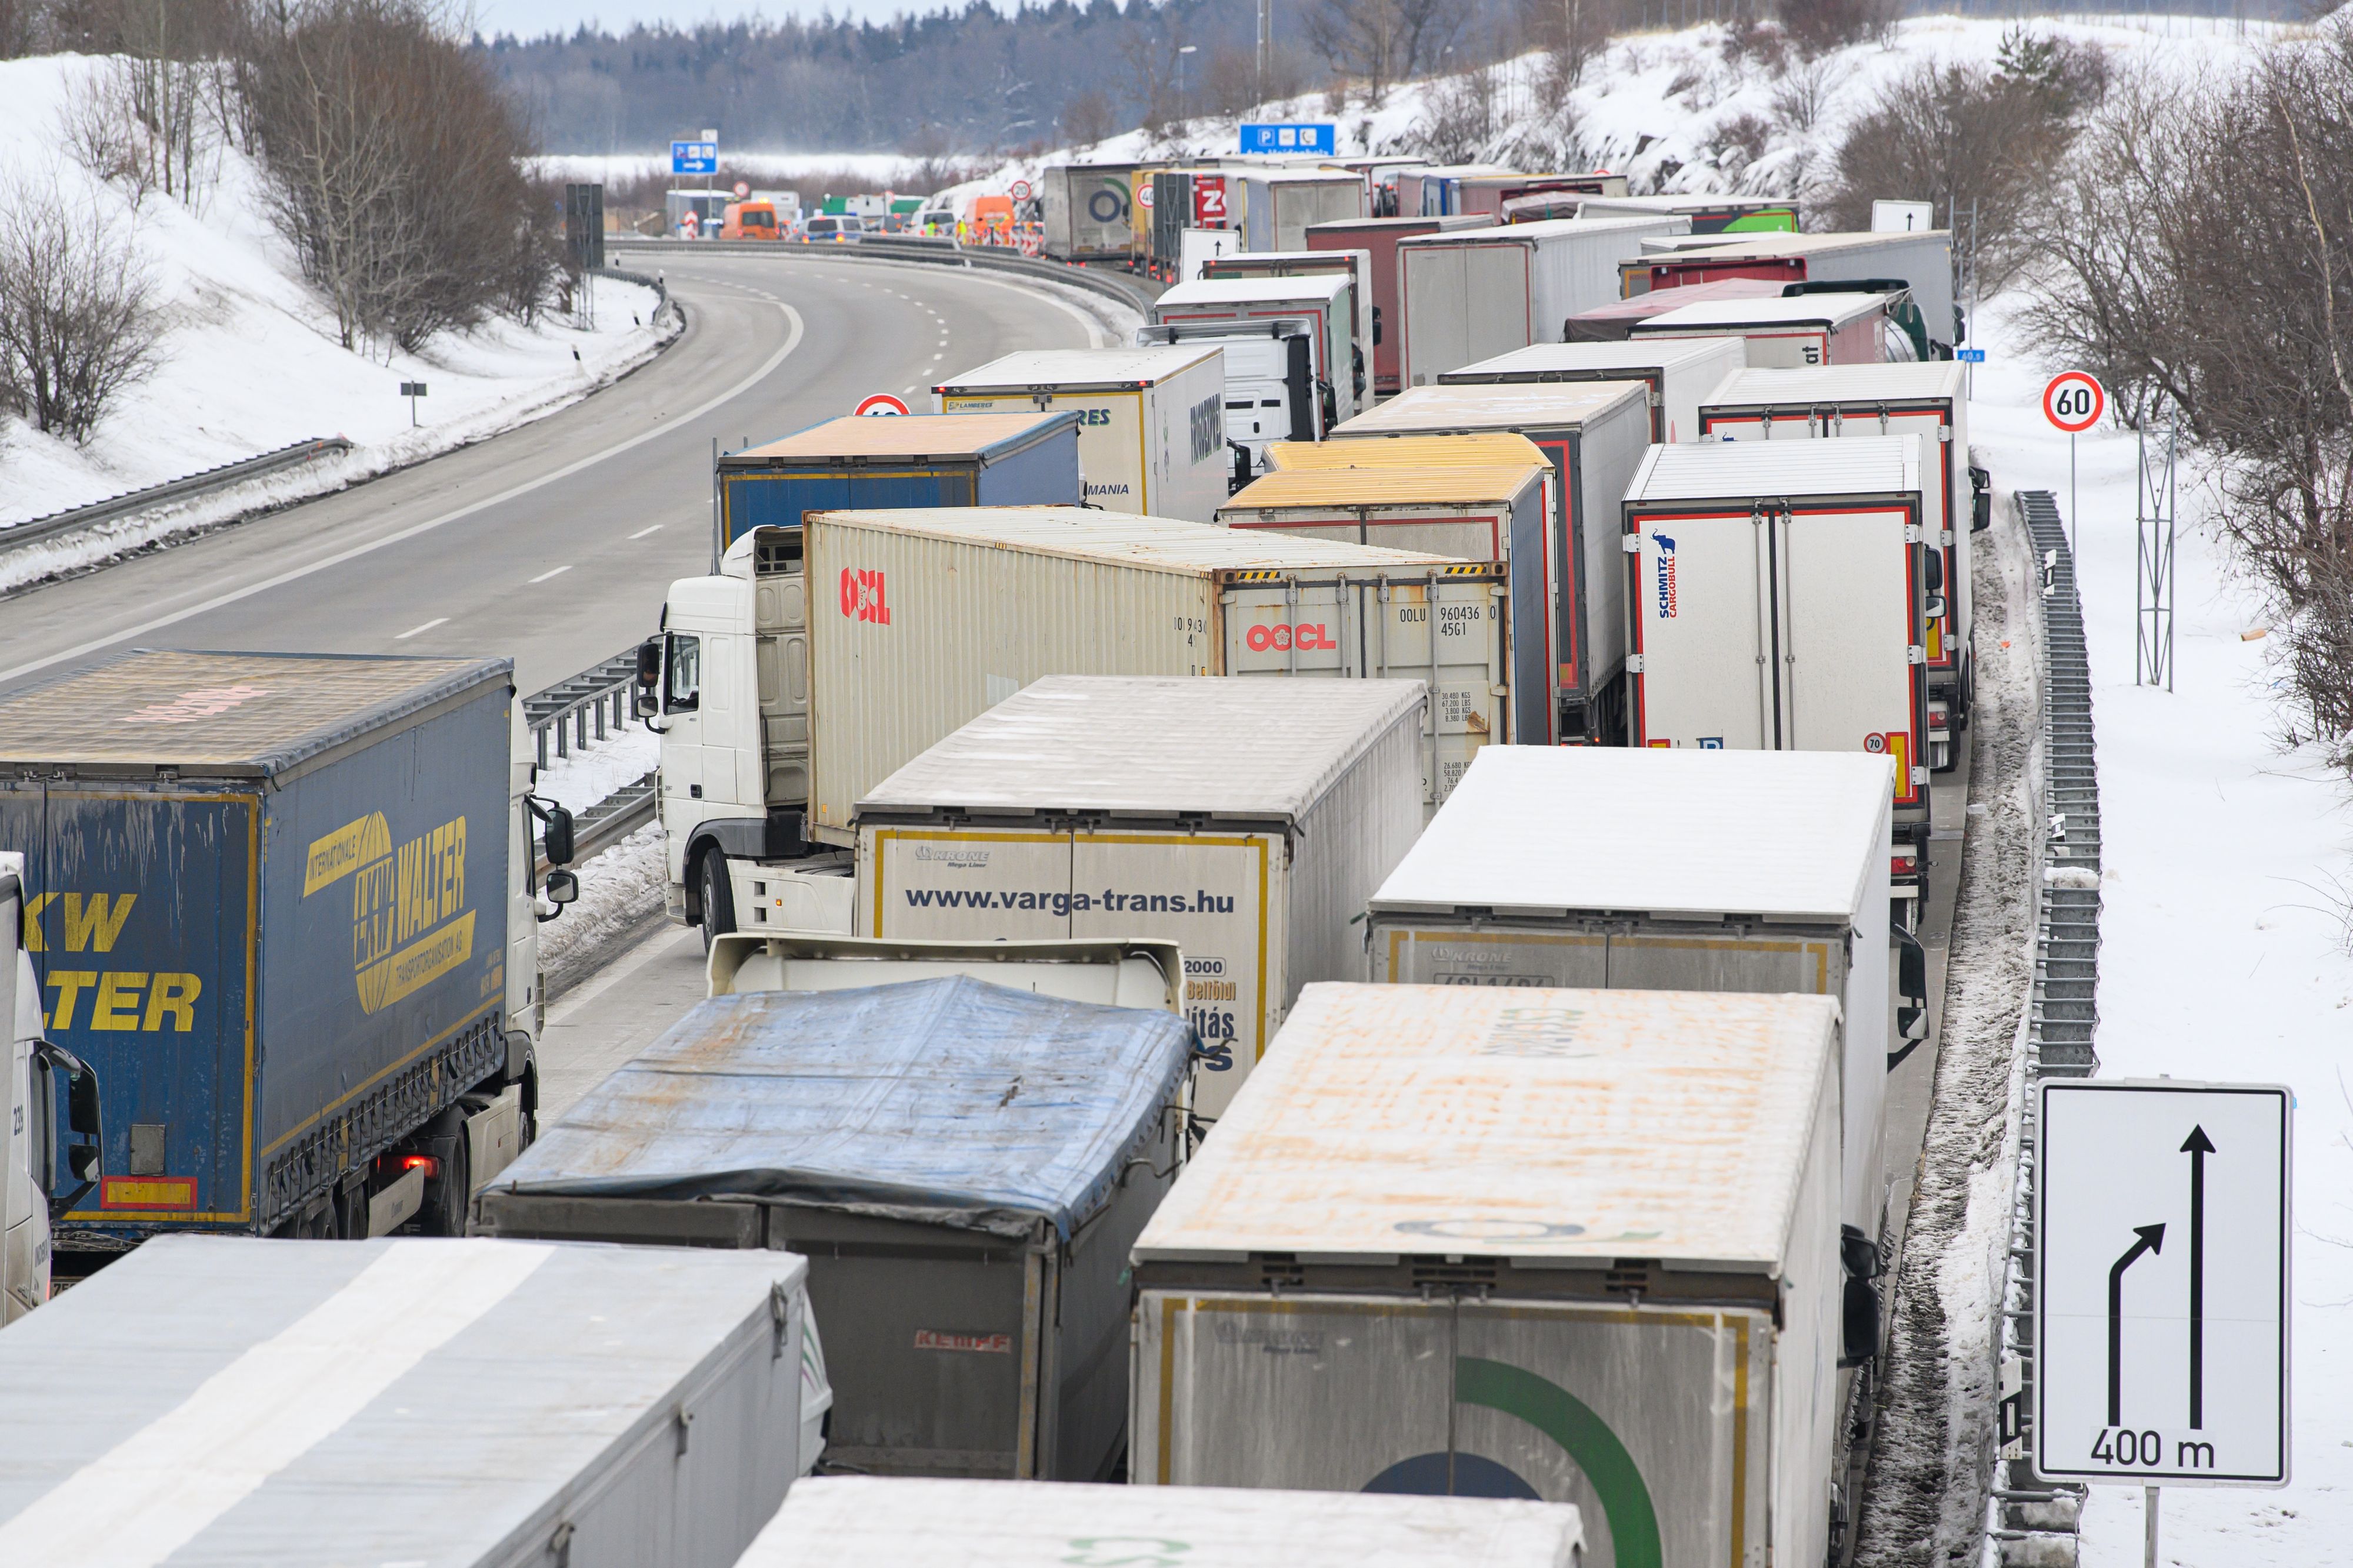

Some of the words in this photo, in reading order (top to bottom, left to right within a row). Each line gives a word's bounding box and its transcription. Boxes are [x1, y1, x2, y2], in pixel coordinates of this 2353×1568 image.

[1016, 185, 1027, 195] 20
[2057, 389, 2089, 415] 60
[1658, 556, 1669, 619] SCHMITZ
[1668, 556, 1677, 618] CARGOBULL
[1441, 606, 1479, 620] 960436
[1247, 623, 1336, 652] OOCL
[1441, 622, 1466, 636] 45G1
[1869, 739, 1880, 749] 70
[309, 834, 356, 881] INTERNATIONALE
[934, 850, 991, 862] KRONE
[398, 815, 466, 944] WALTER
[905, 889, 1235, 916] www.varga-trans.hu
[1184, 960, 1222, 973] 2000
[44, 970, 202, 1032] TER
[2090, 1428, 2161, 1466] 400
[2178, 1440, 2214, 1468] m
